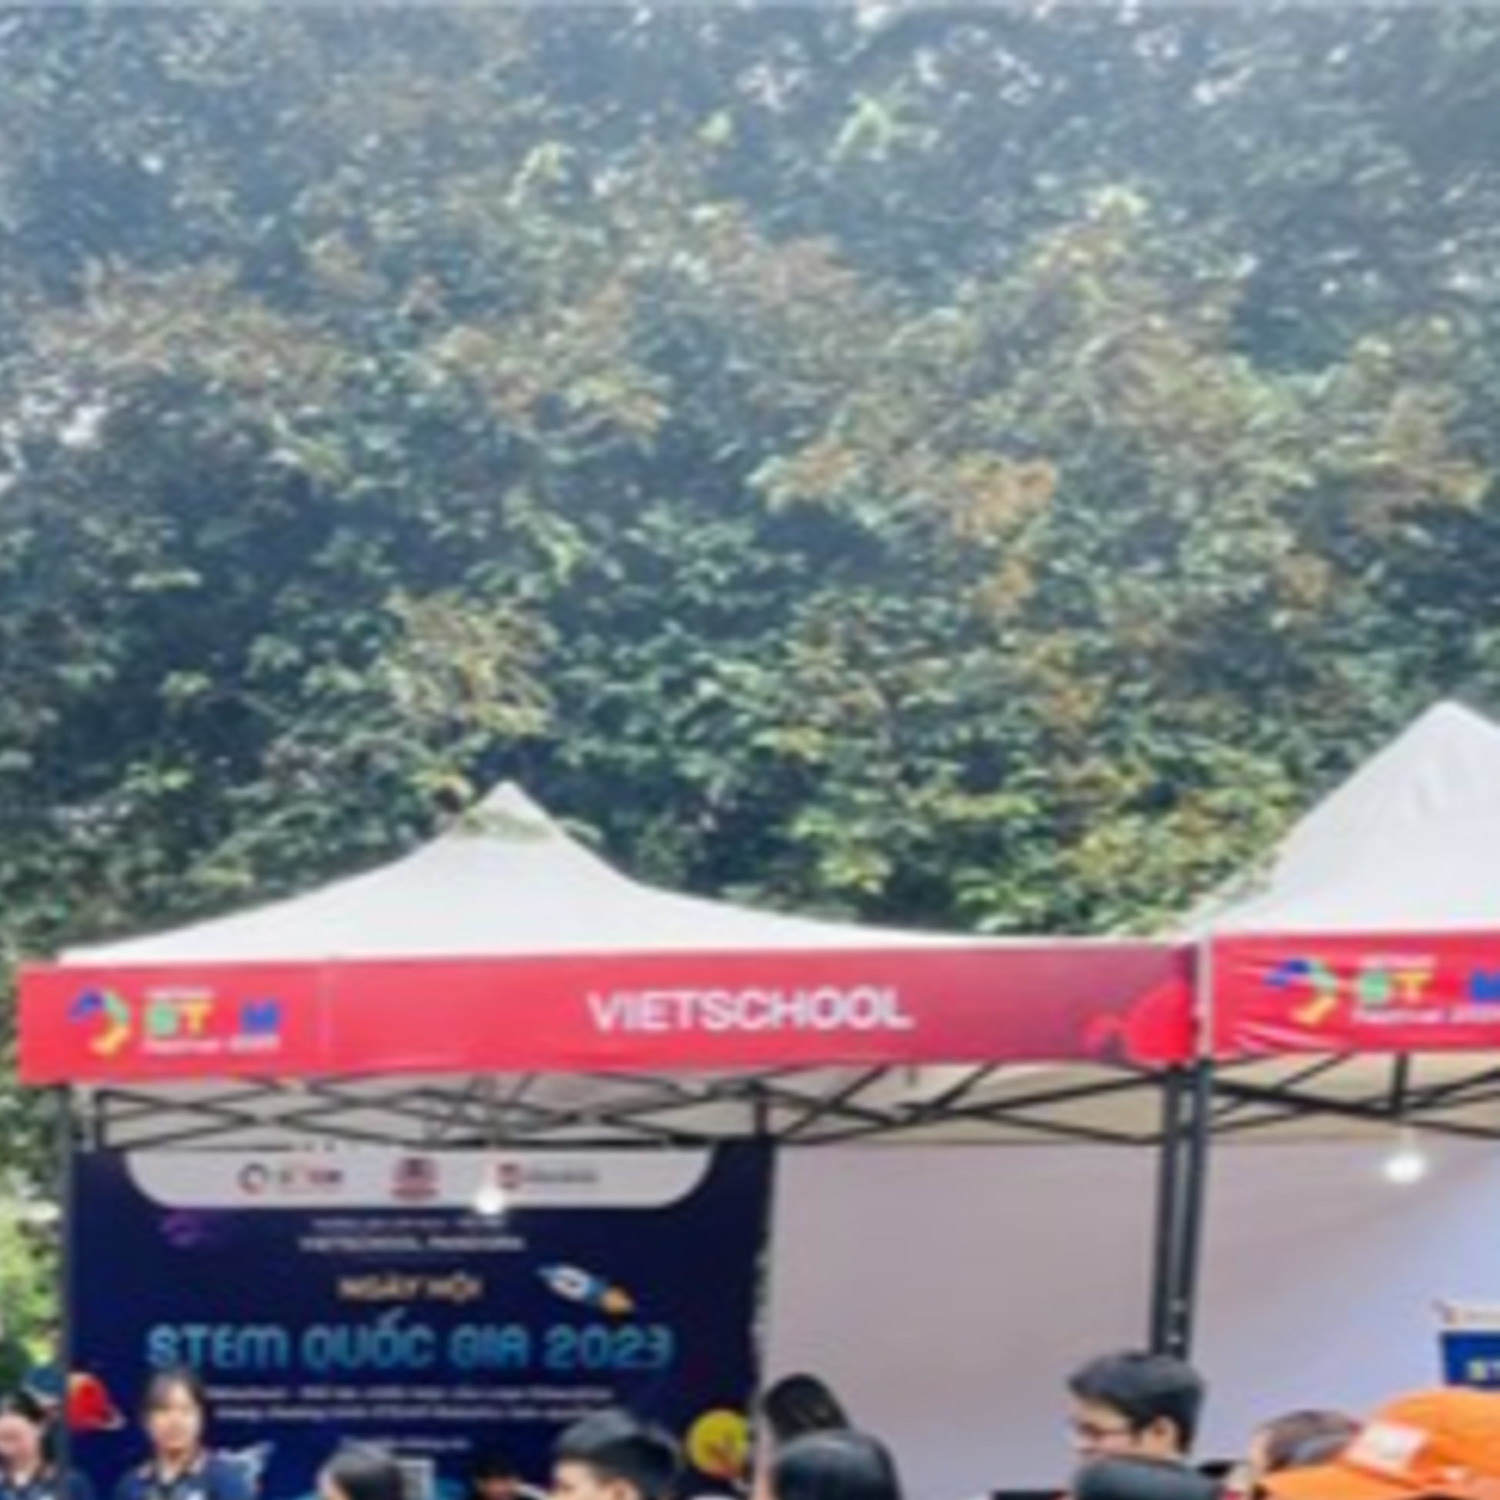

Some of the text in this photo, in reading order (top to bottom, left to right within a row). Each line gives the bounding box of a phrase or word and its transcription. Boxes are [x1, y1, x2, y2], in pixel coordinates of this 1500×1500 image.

[585, 984, 916, 1033] VIETSCHOOL
[146, 1306, 675, 1370] STEM QUỐC GIA 2023
